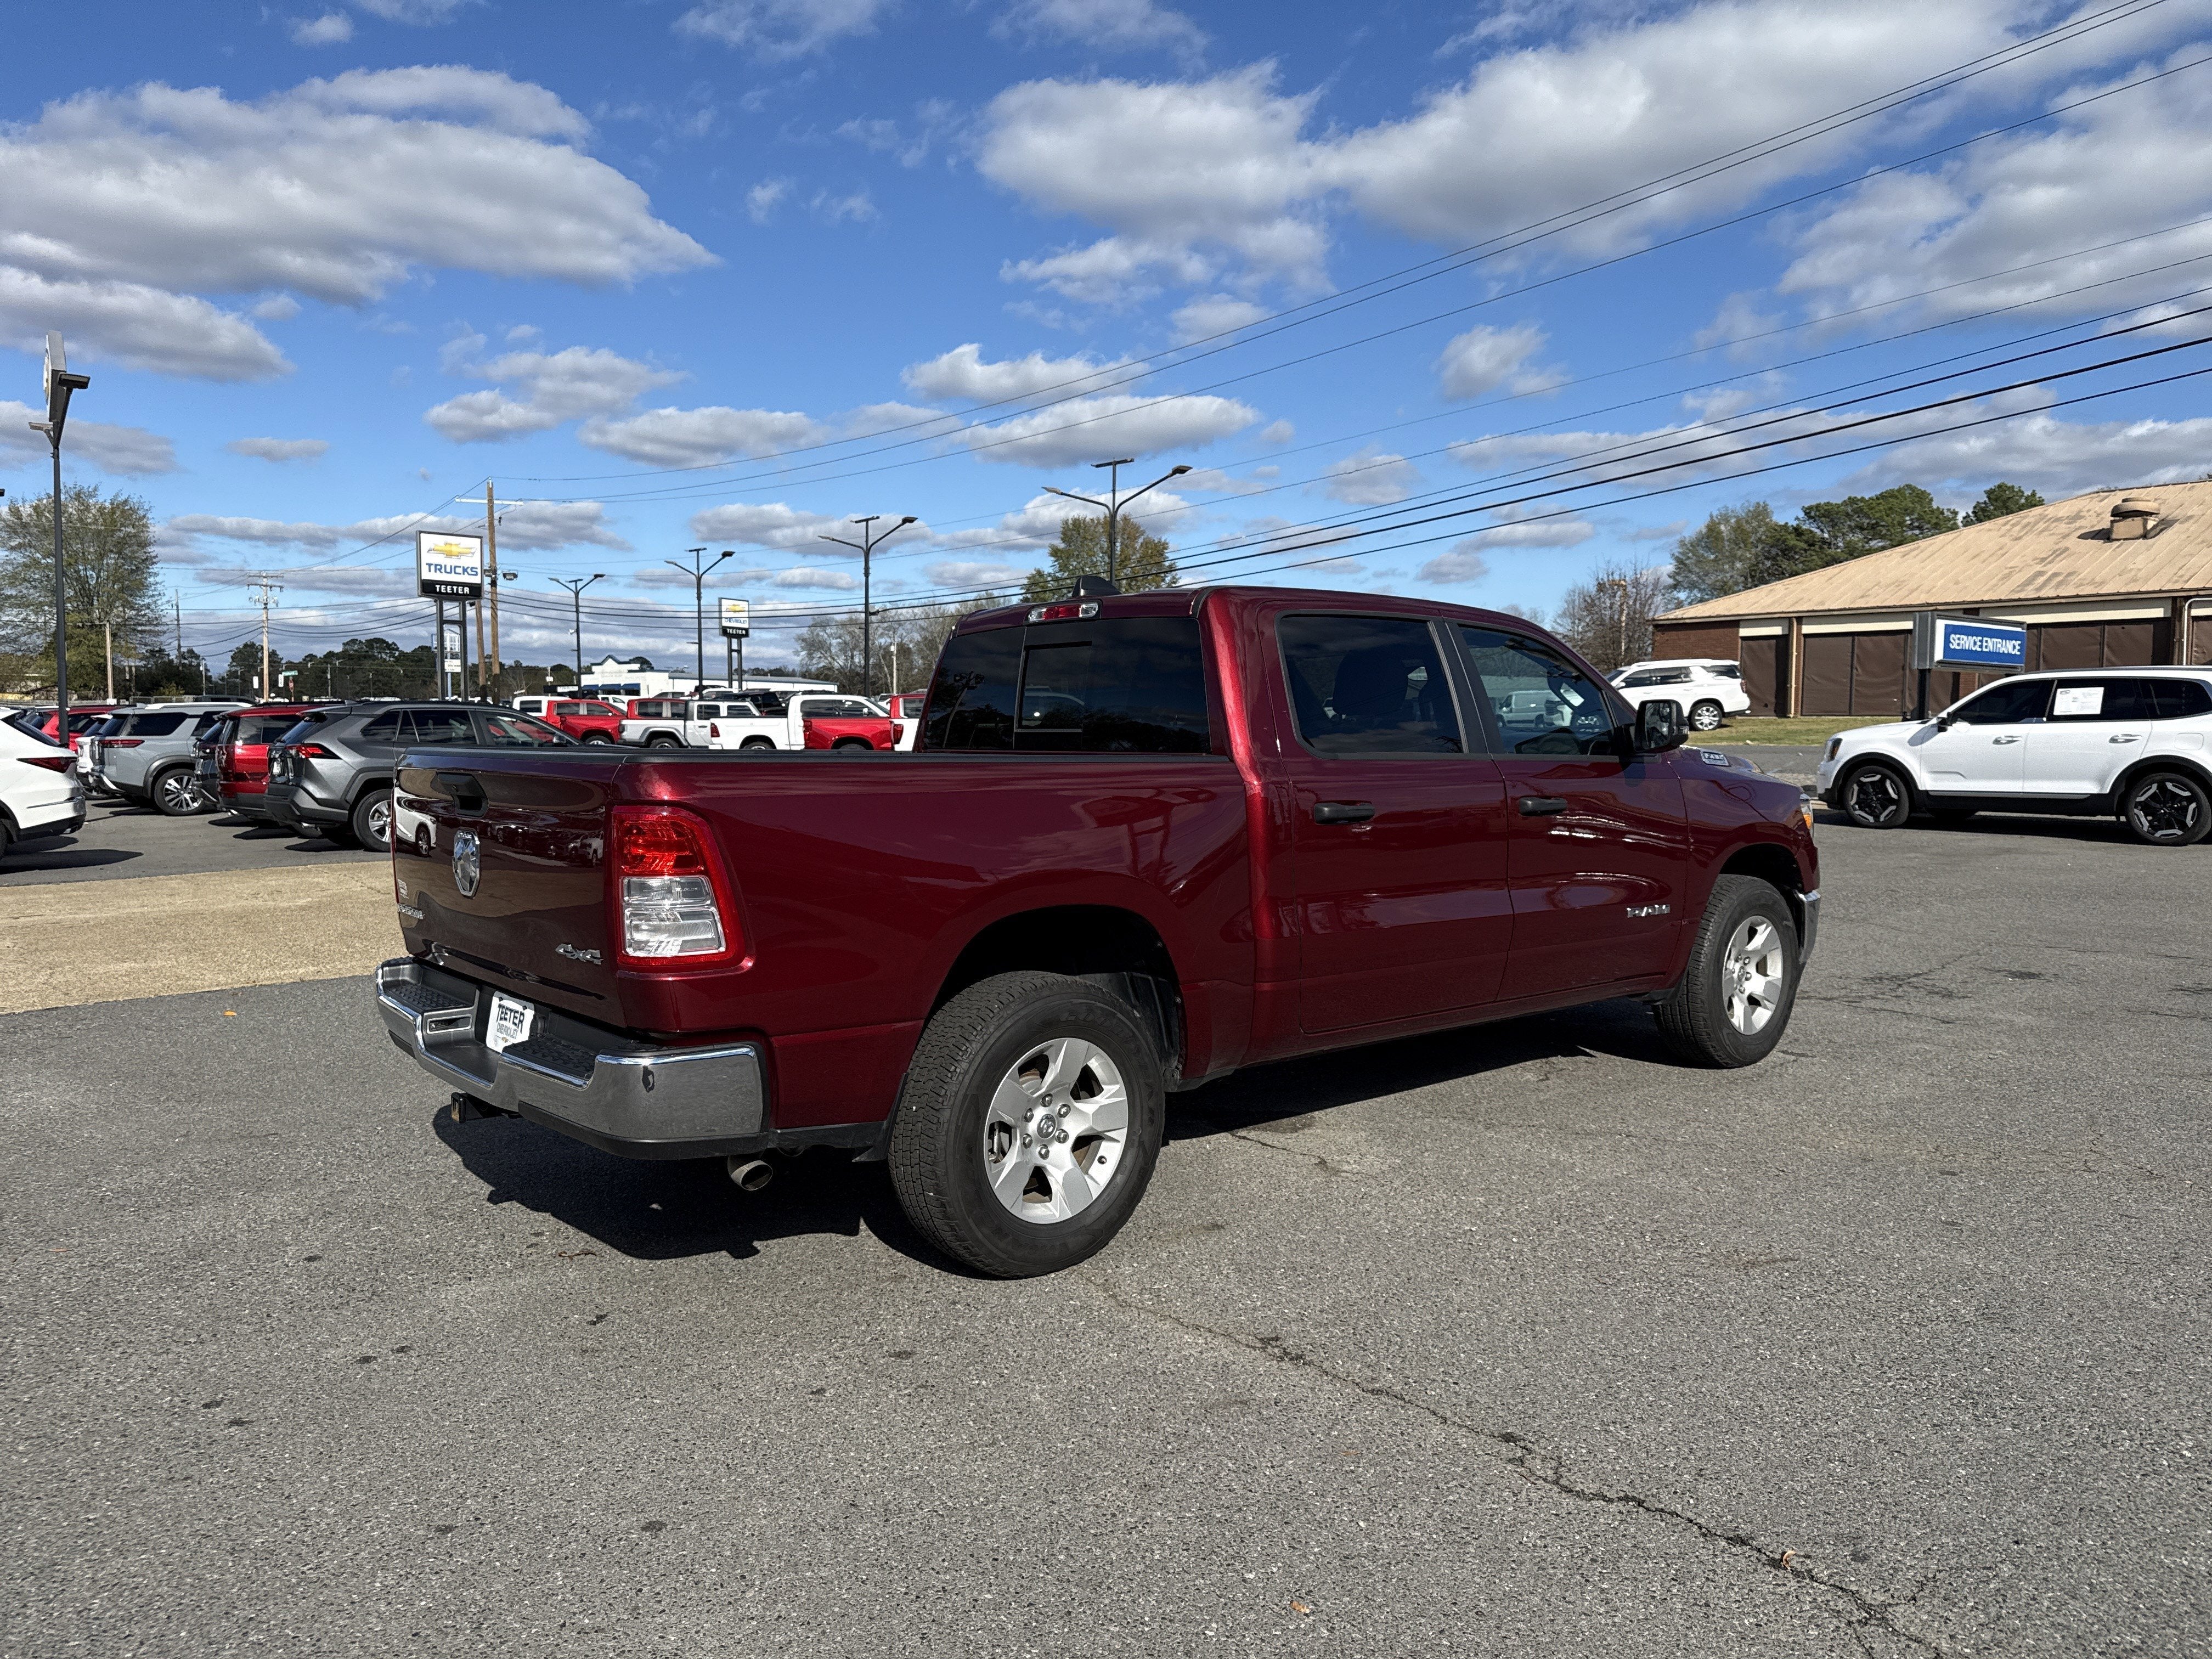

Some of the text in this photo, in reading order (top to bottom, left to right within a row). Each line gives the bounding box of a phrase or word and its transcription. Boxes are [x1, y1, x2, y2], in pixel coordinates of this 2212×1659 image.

[426, 563, 478, 576] TRUCKS
[436, 585, 469, 594] TEETER
[1949, 634, 2021, 654] SERVICE ENTRANCE
[1627, 904, 1670, 918] RAM
[496, 1003, 525, 1034] TEETER
